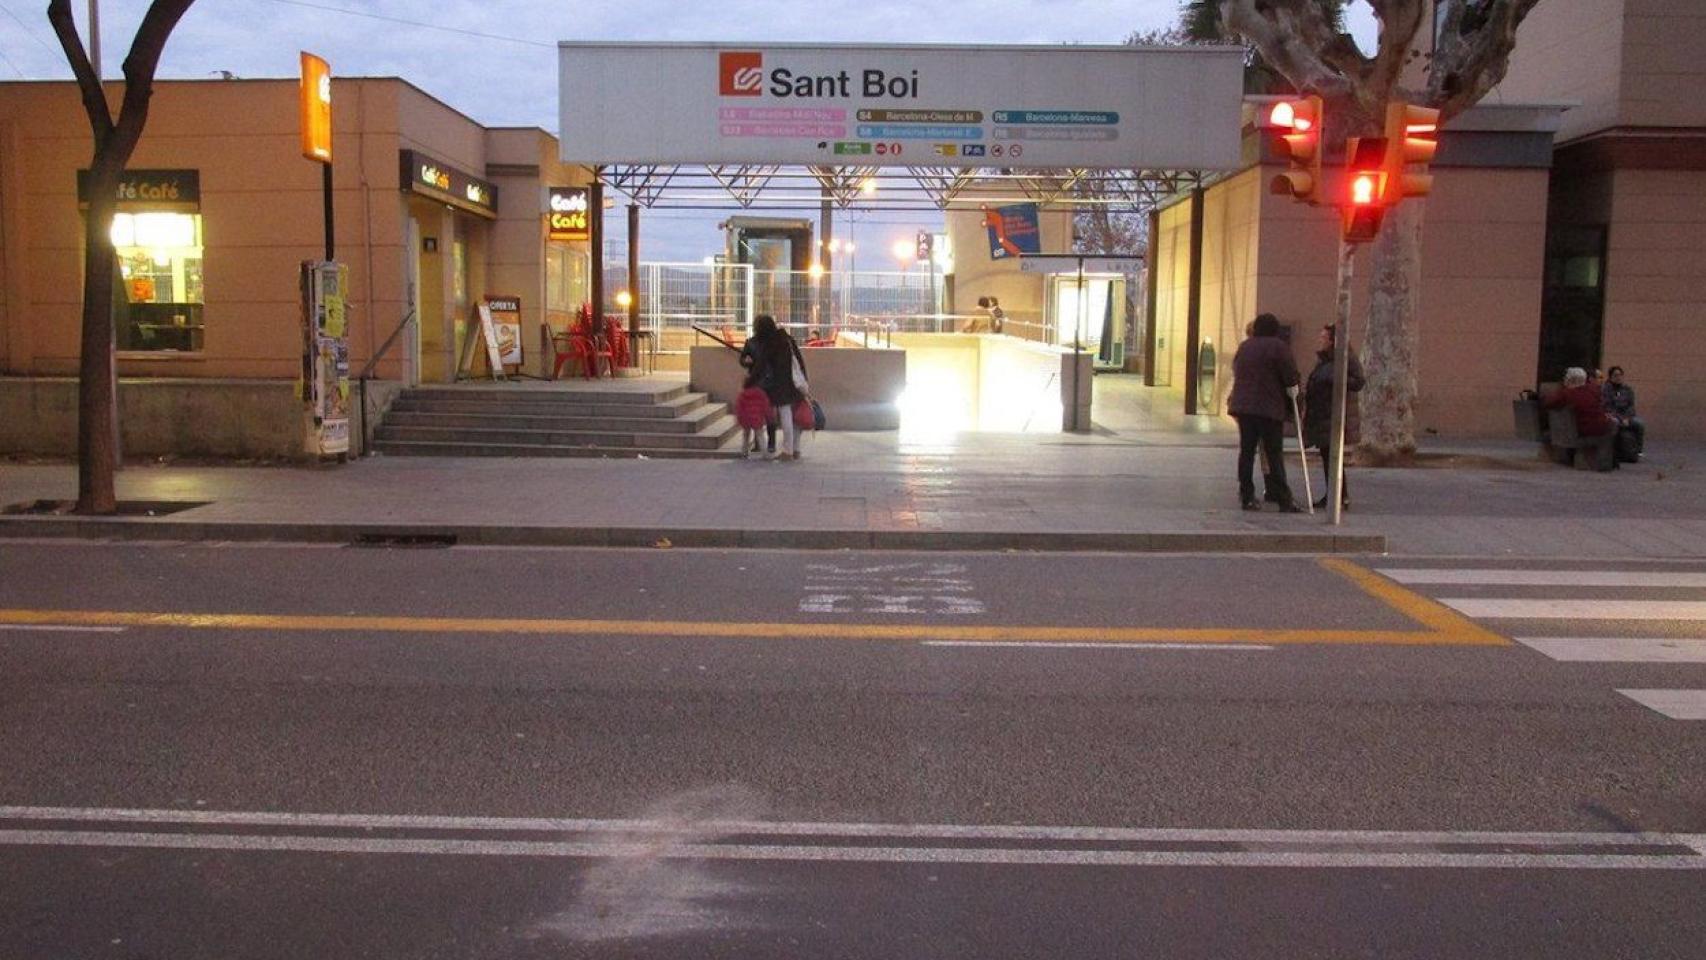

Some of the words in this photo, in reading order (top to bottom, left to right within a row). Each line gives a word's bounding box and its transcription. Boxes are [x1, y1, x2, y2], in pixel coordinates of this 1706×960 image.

[770, 67, 850, 98] Sant
[862, 69, 919, 98] Boi
[859, 110, 872, 120] S4
[994, 111, 1008, 121] R5
[140, 181, 178, 199] Café
[550, 192, 587, 211] Café
[551, 211, 586, 228] Café
